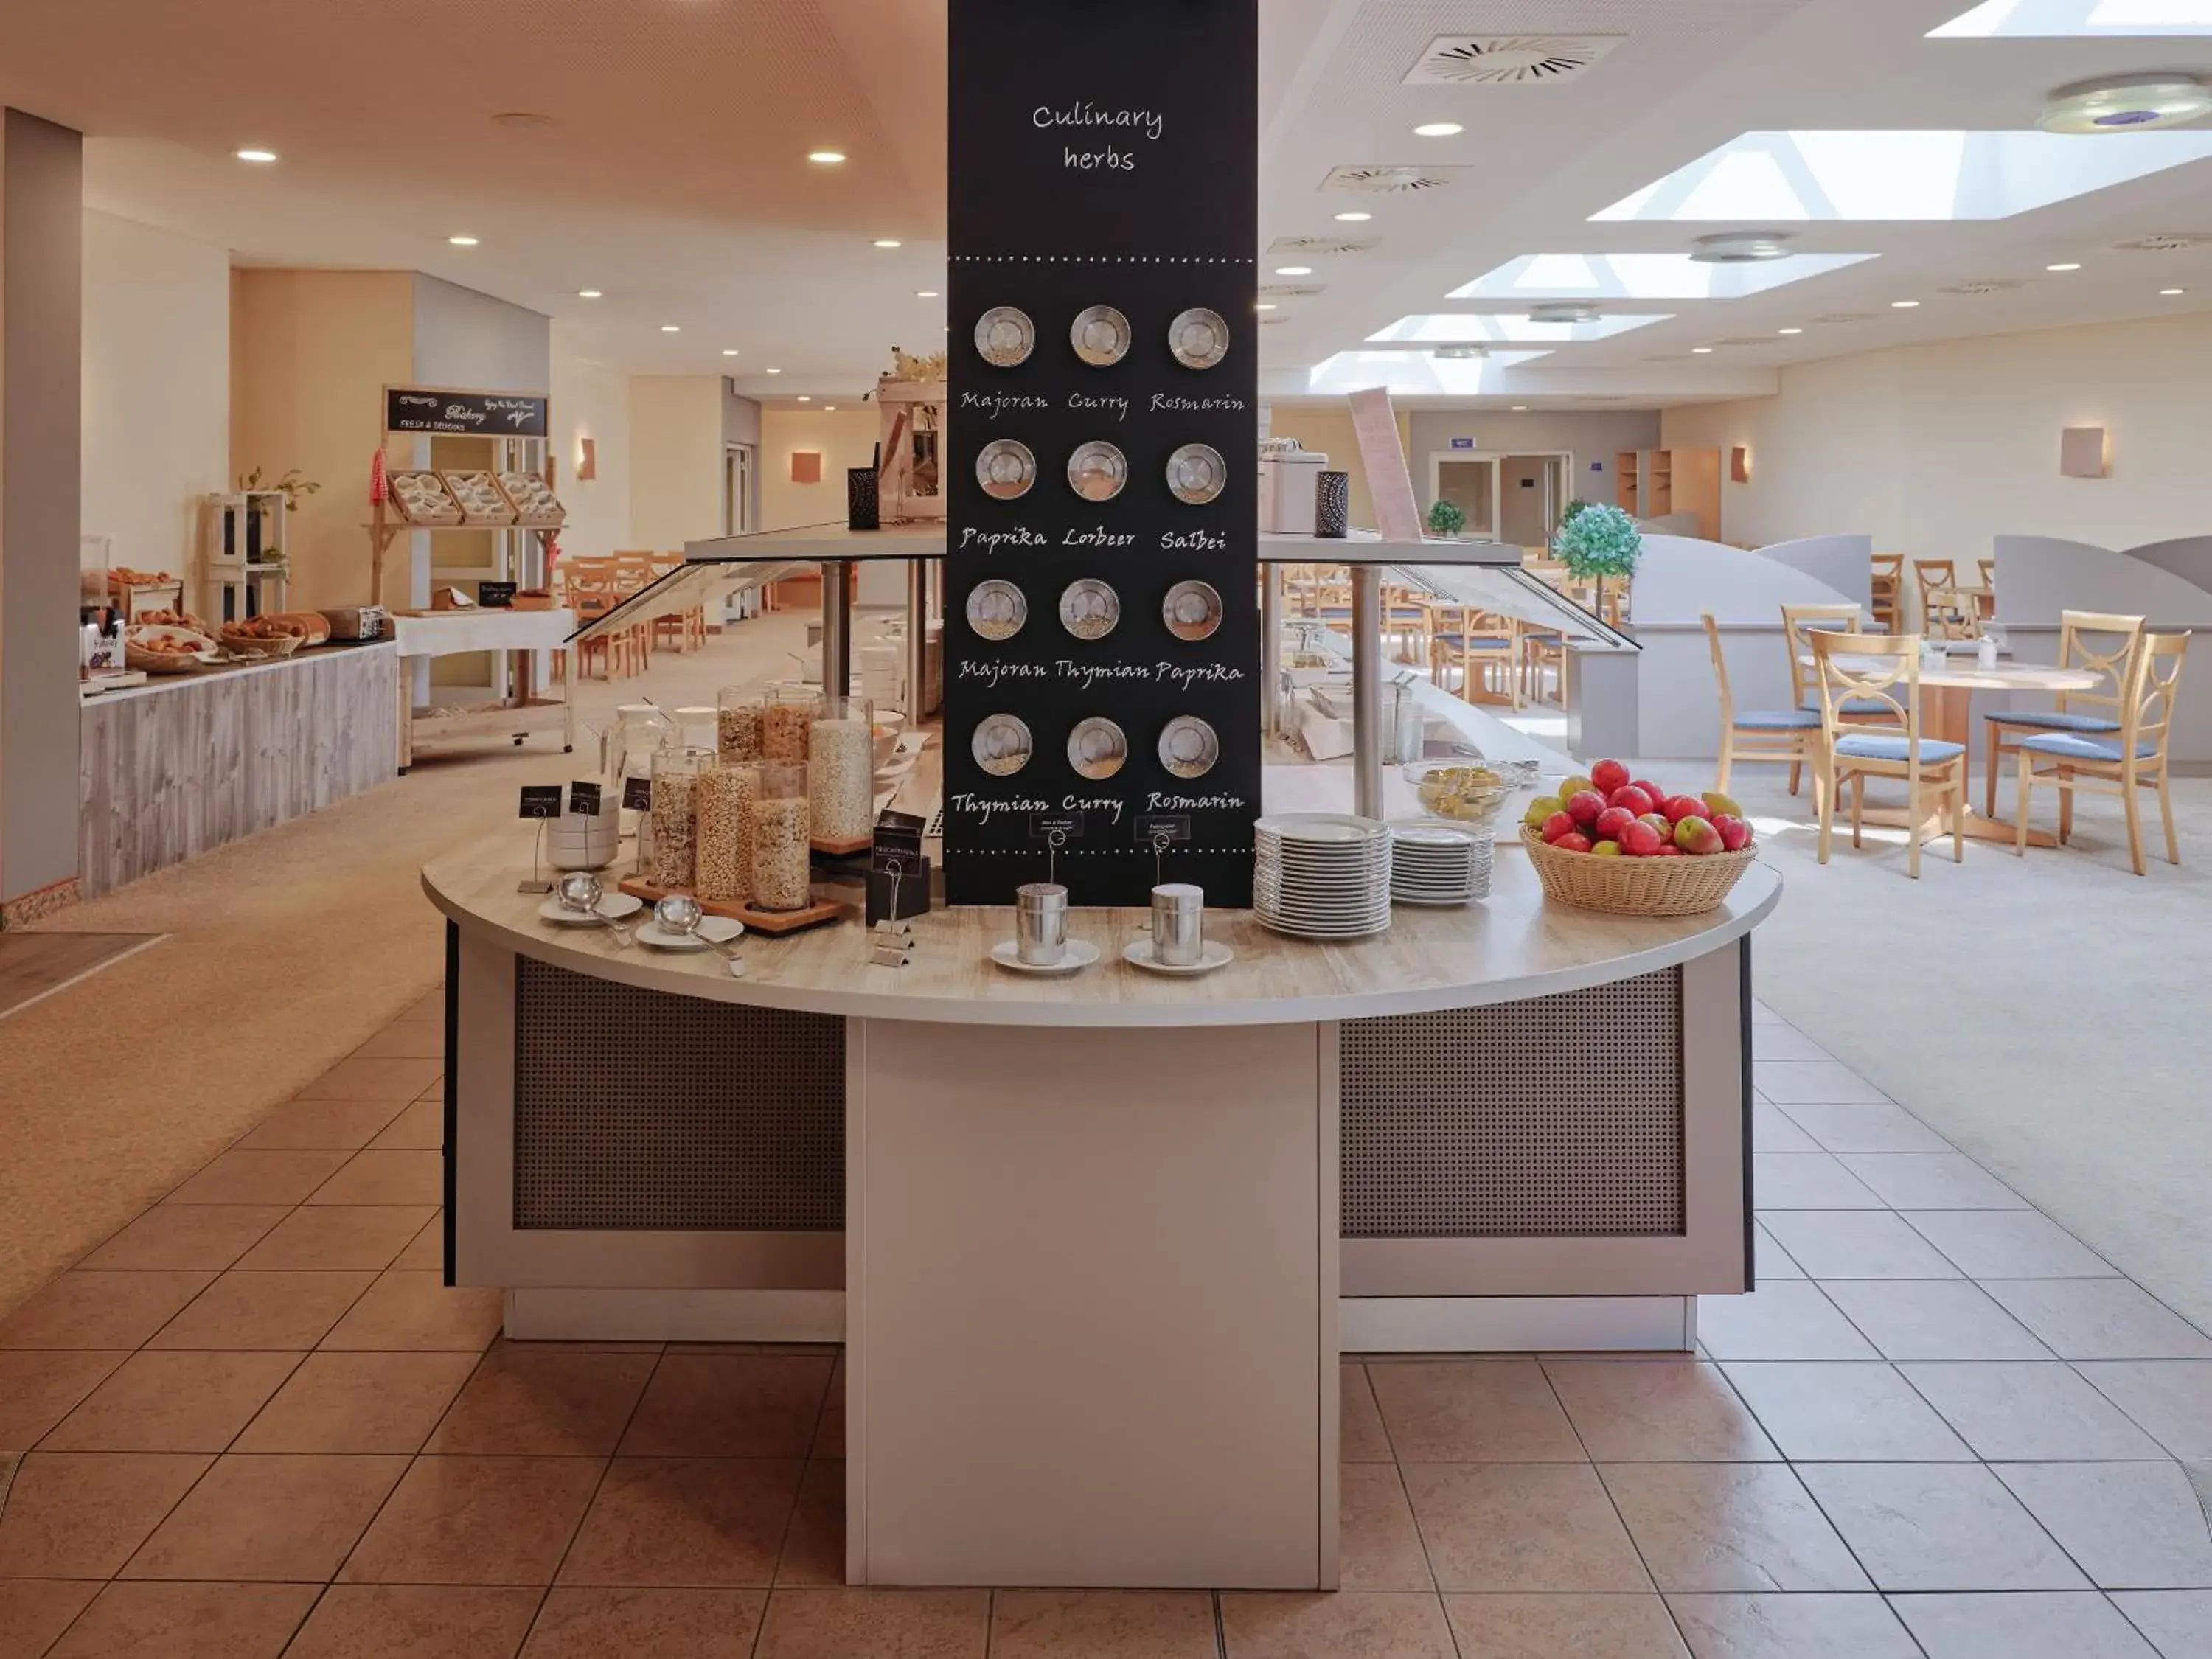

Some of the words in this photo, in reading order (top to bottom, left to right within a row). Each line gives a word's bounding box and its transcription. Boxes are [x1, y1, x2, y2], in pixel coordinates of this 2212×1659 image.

[1034, 102, 1161, 139] Culinary
[1065, 145, 1134, 170] herbs
[961, 391, 1048, 419] Majoran
[1069, 393, 1128, 421] Curry
[1150, 394, 1245, 411] Rosmarin
[961, 526, 1047, 554] Paprika
[1062, 526, 1135, 546] Lorbeer
[1161, 530, 1225, 550] Salbei
[959, 660, 1047, 687] Majoran
[1056, 661, 1150, 689] Thymian
[1156, 662, 1245, 691] Paprika
[952, 793, 1051, 824] Thymian
[1063, 795, 1123, 824] Curry
[1147, 792, 1244, 811] Rosmarin
